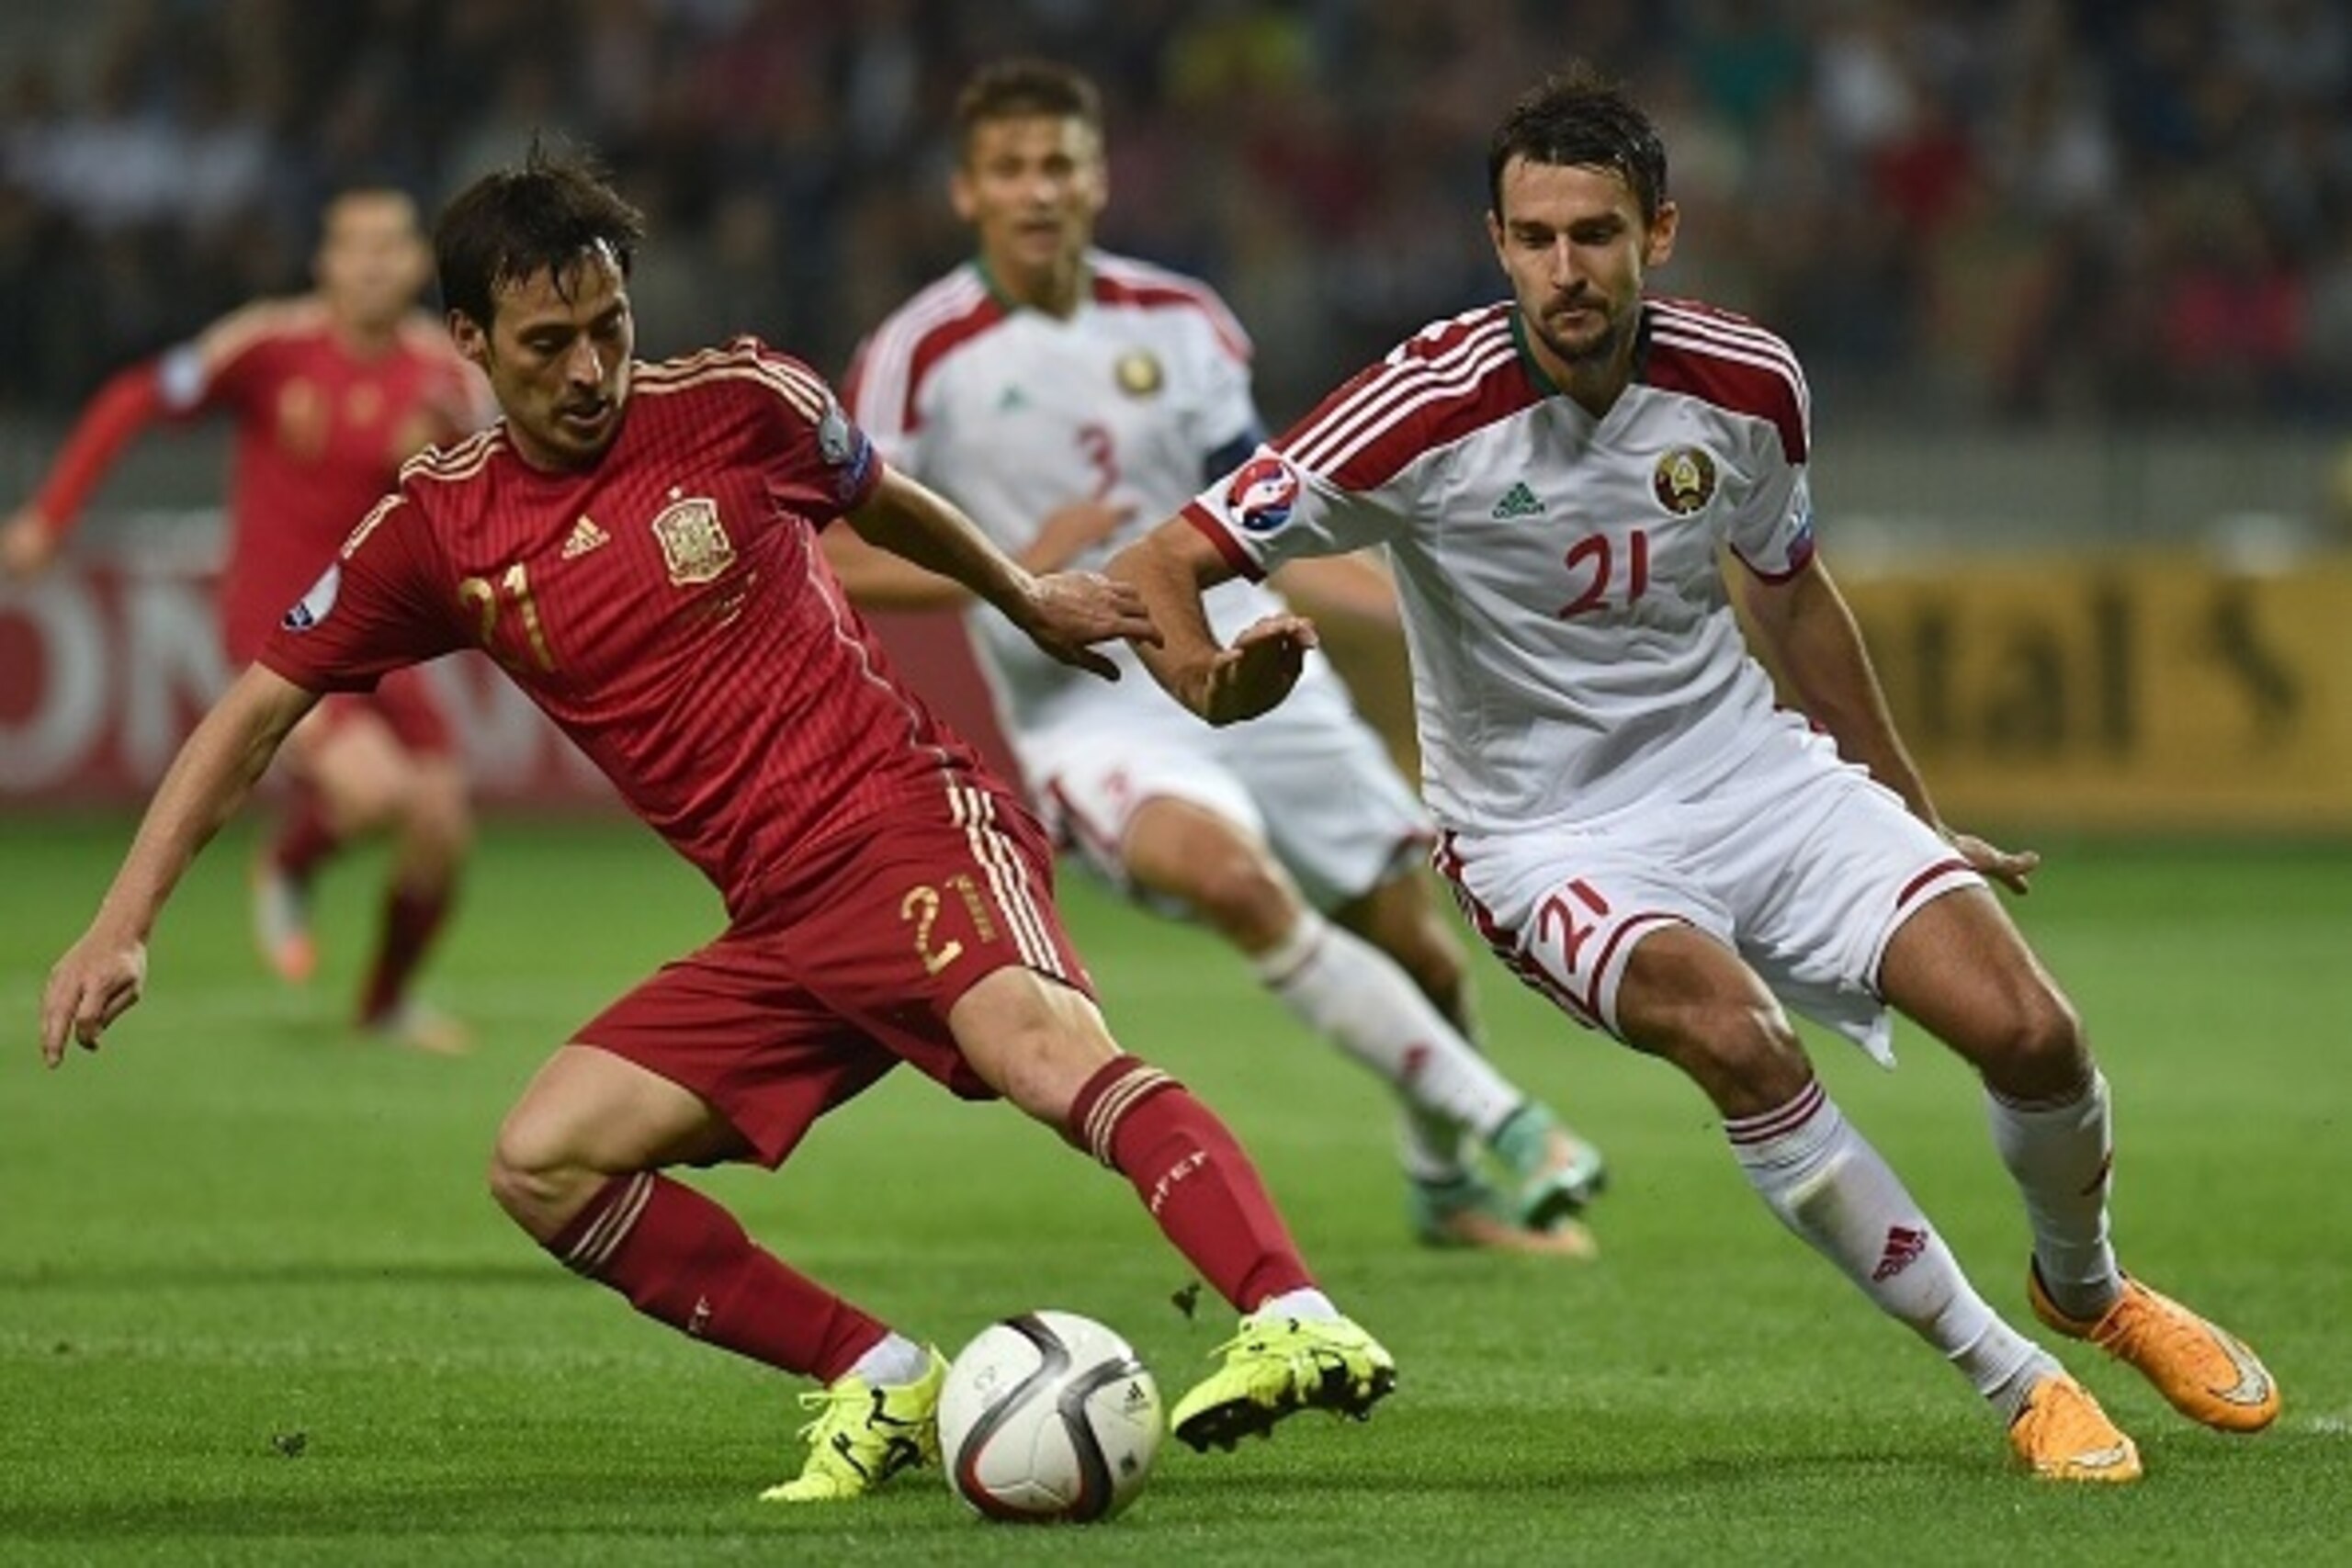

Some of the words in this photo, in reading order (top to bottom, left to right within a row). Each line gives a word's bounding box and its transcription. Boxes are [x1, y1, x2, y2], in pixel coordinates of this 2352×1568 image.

[458, 561, 553, 673] 21
[1559, 529, 1648, 622] 21
[900, 874, 998, 976] 21
[1538, 877, 1610, 976] 21
